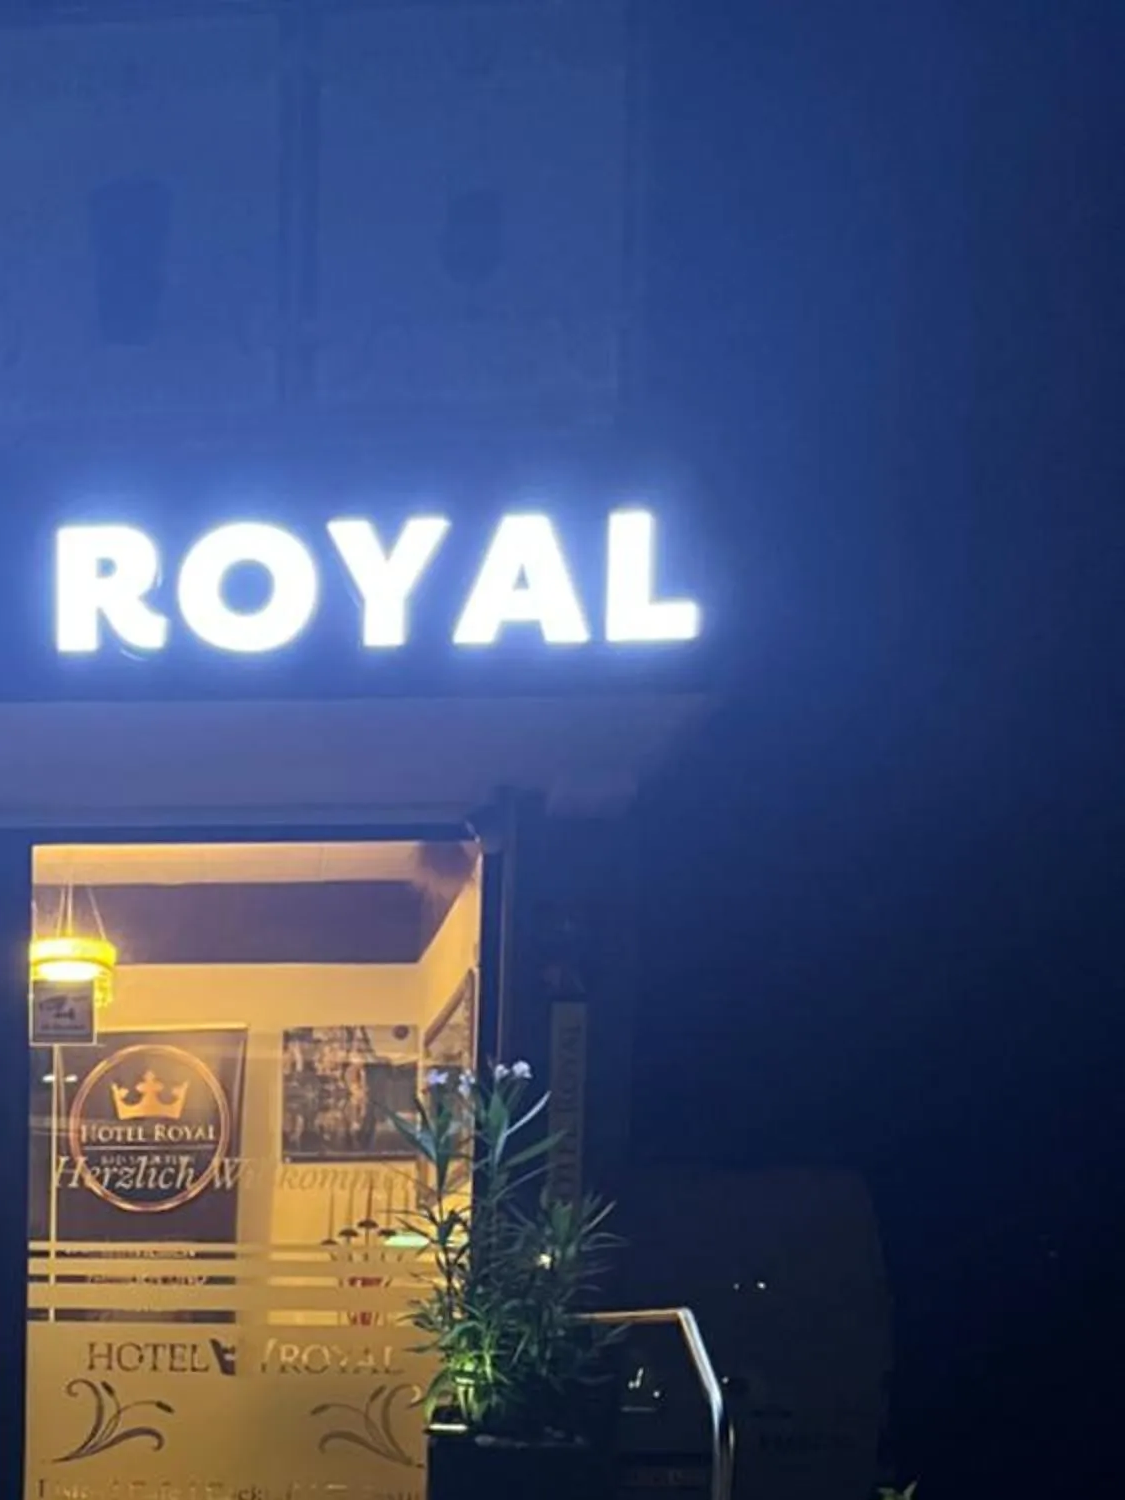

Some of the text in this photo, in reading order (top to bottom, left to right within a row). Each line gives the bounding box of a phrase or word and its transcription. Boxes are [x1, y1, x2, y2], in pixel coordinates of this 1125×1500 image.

[56, 510, 698, 652] ROYAL
[80, 1122, 216, 1143] HOTEL ROYAL
[56, 1155, 196, 1190] Herzlich
[87, 1342, 406, 1376] HOTEL ROYAL
